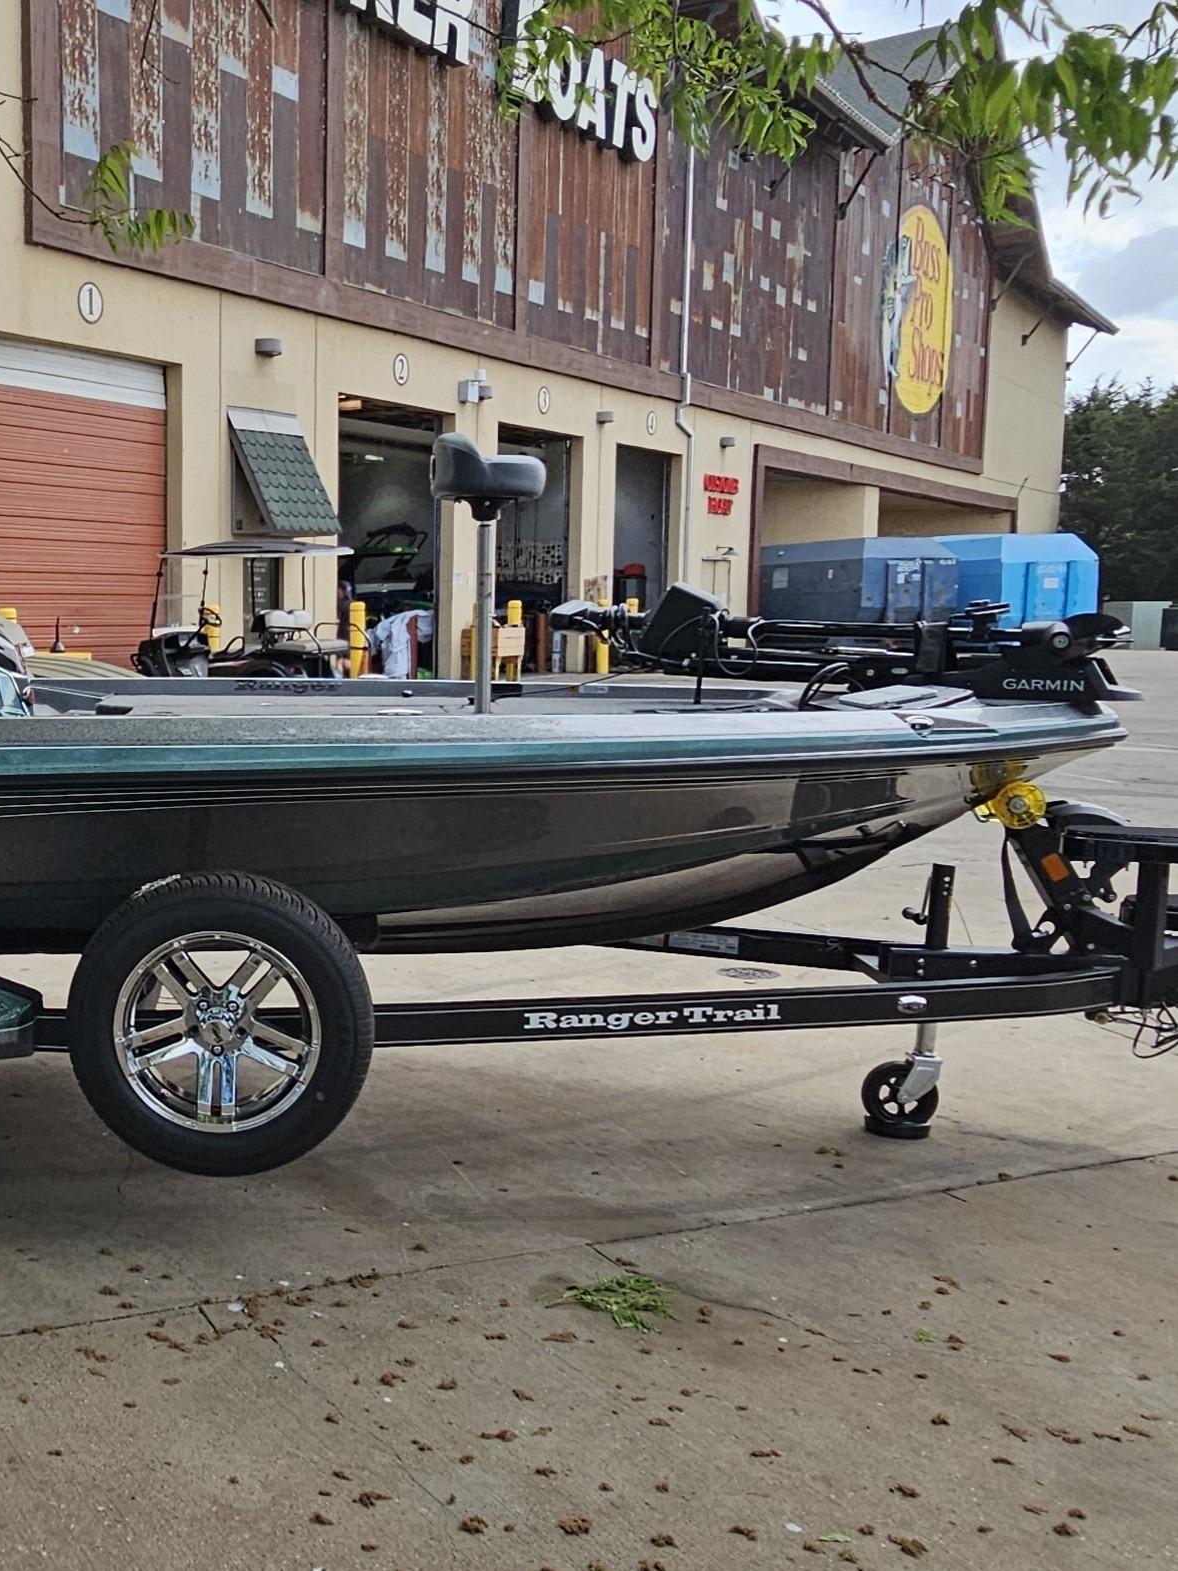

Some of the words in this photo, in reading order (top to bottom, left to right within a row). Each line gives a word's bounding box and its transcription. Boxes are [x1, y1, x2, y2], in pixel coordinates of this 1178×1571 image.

[913, 217, 941, 283] Bass
[910, 274, 934, 331] Pro
[908, 326, 943, 397] Shops
[1002, 678, 1085, 692] GARMIN
[524, 1011, 679, 1030] Ranger
[683, 1003, 781, 1024] Trail
